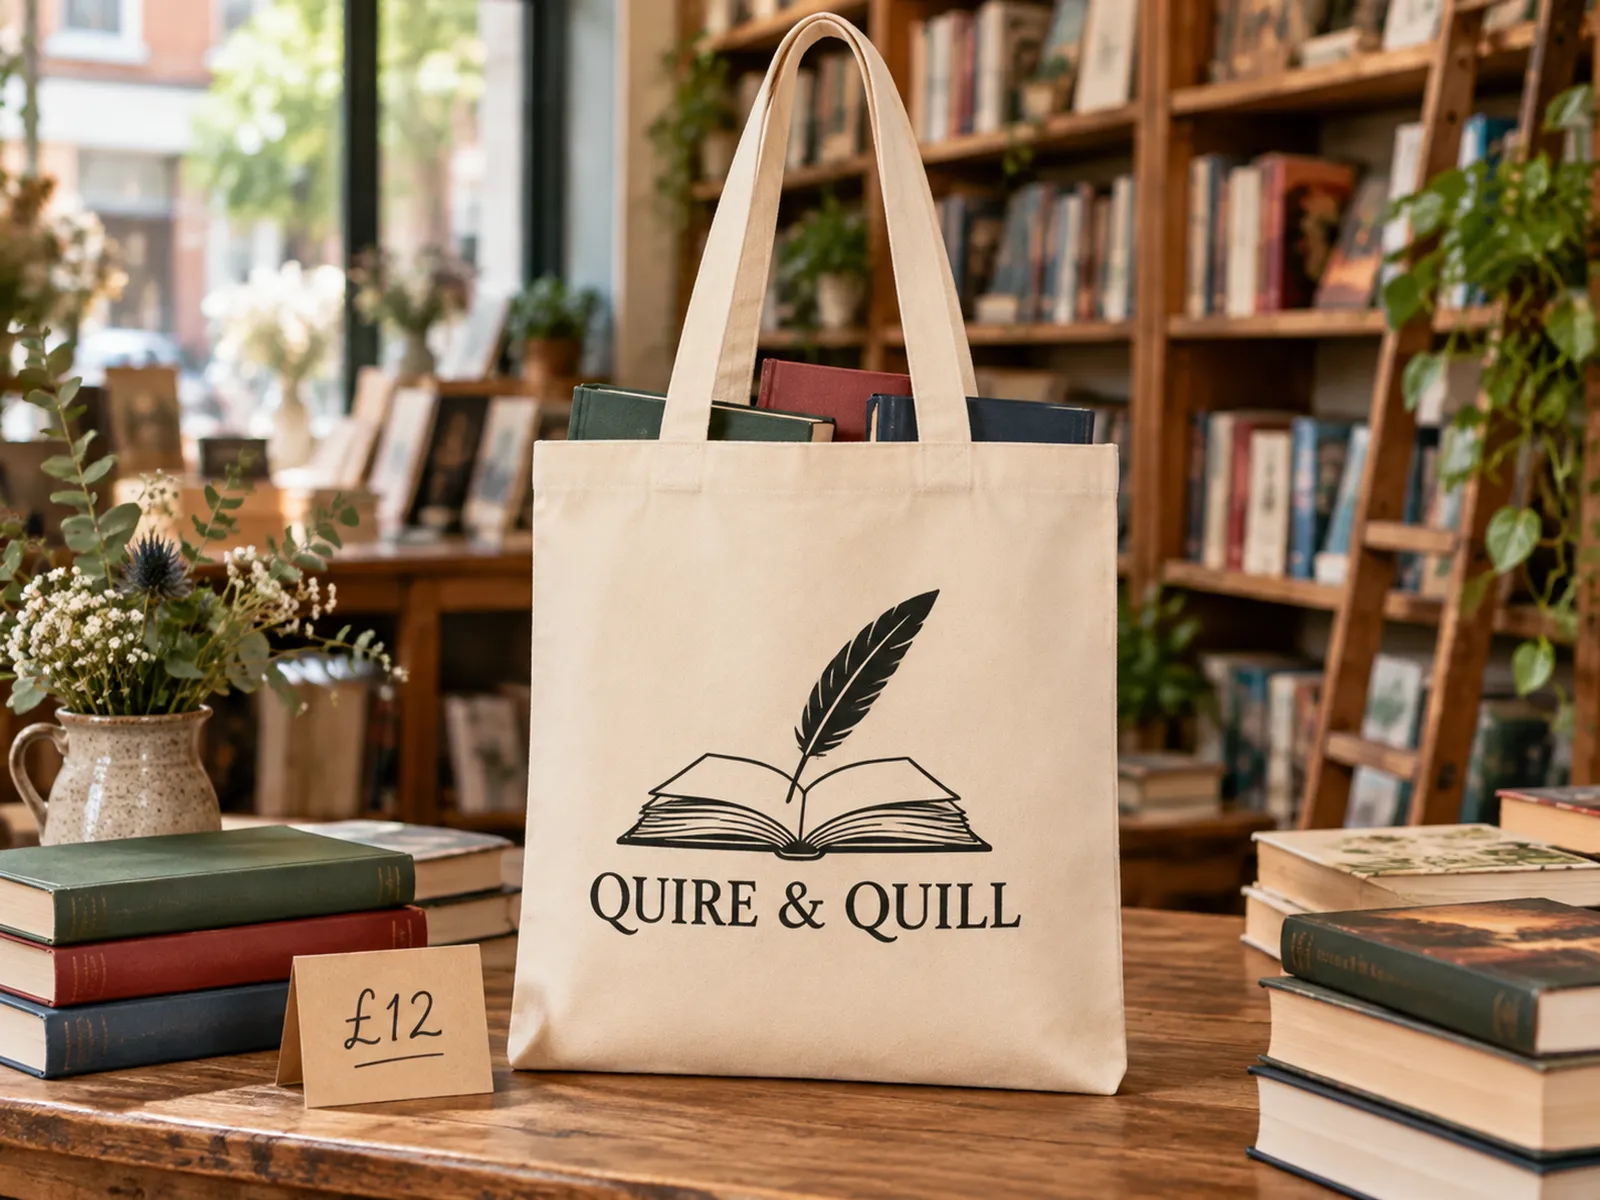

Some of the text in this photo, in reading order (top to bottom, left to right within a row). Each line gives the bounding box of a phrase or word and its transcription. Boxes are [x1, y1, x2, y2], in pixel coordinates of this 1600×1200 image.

[589, 871, 1021, 943] QUIRE & QUILL
[343, 987, 443, 1050] £12
